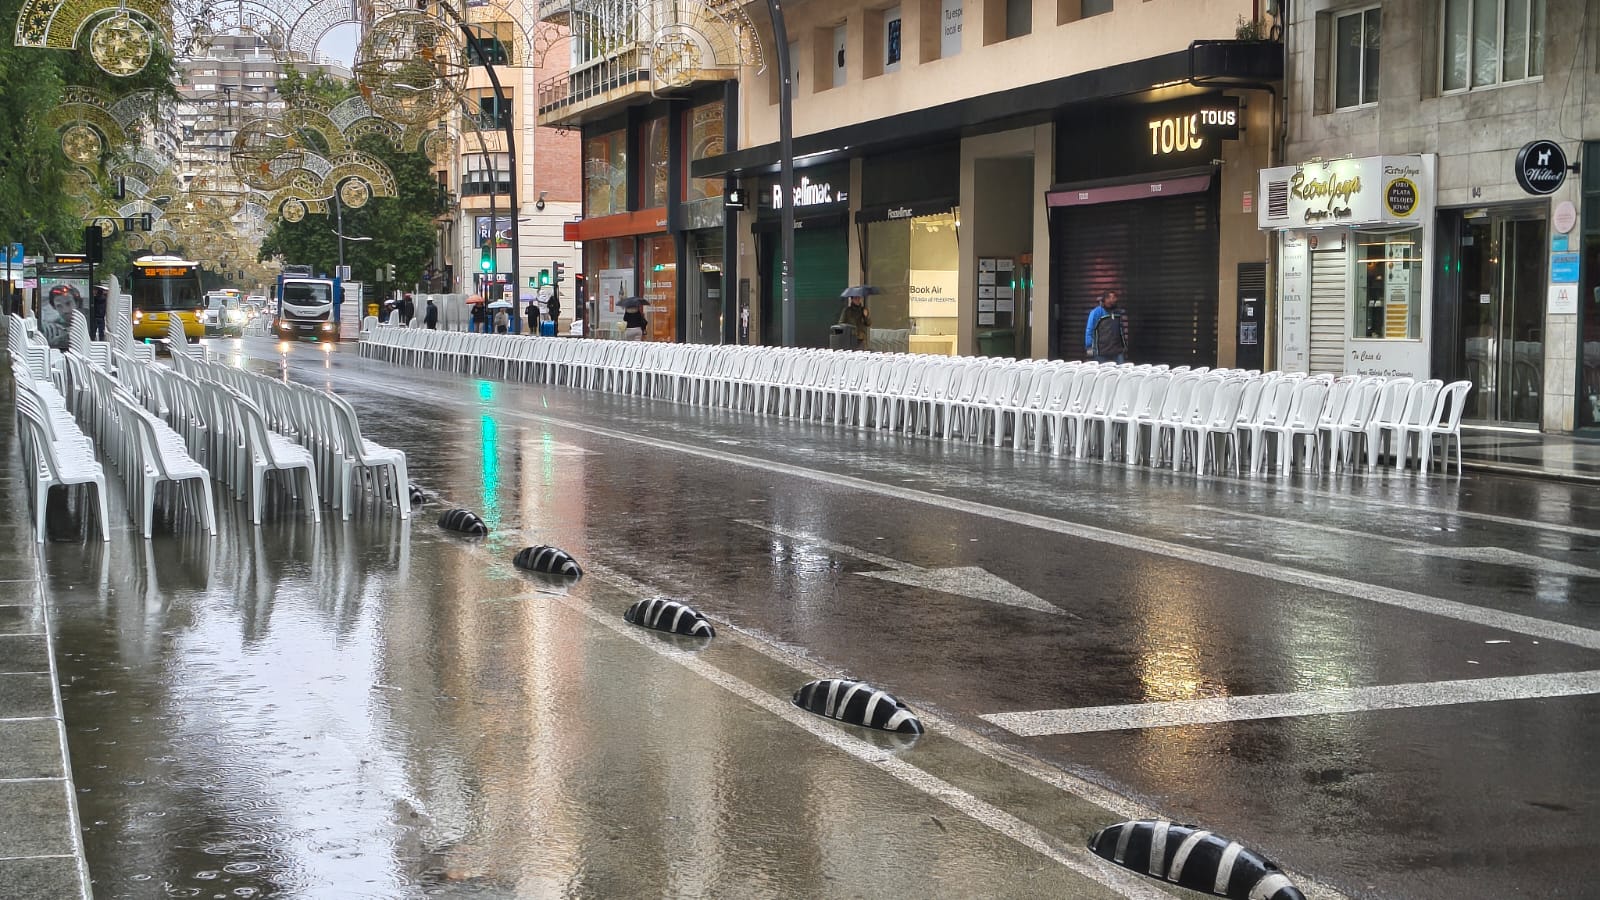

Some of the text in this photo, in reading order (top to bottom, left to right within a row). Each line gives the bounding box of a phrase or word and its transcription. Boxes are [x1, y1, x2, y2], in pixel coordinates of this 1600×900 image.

[1200, 110, 1236, 126] TOUS
[1149, 113, 1203, 155] TOUS
[1389, 196, 1414, 204] RELOJES
[910, 285, 942, 294] Book Air
